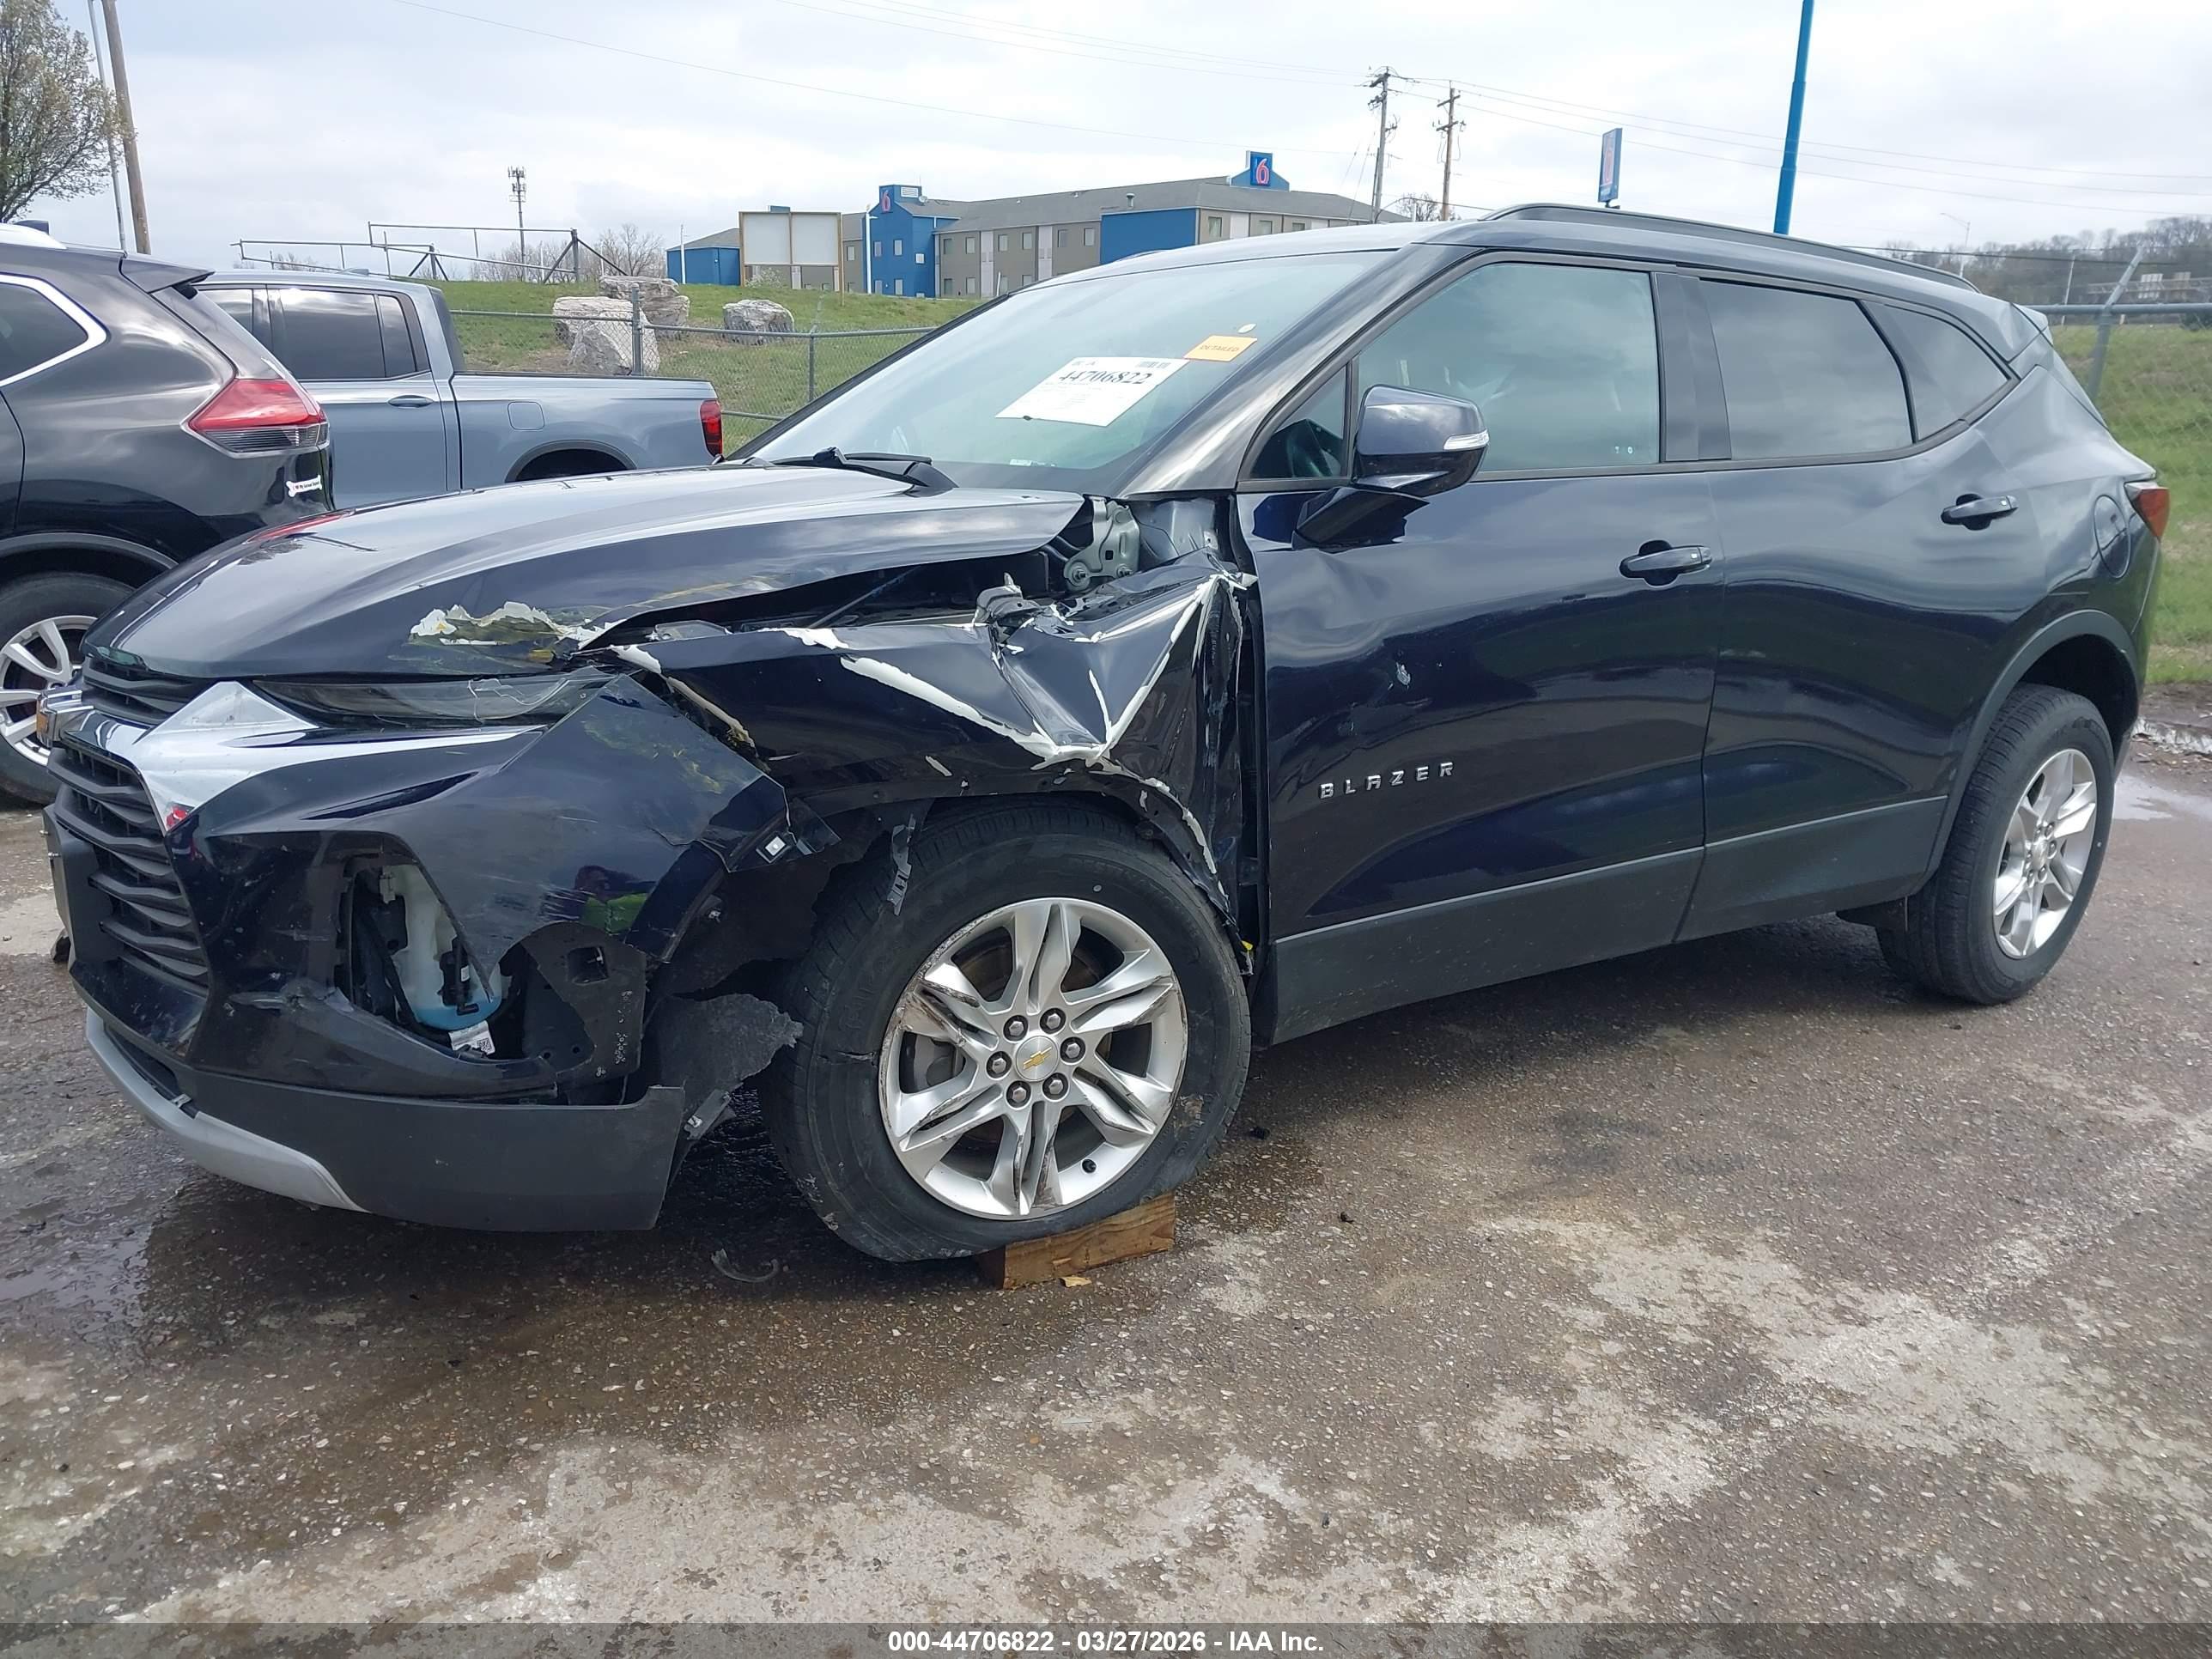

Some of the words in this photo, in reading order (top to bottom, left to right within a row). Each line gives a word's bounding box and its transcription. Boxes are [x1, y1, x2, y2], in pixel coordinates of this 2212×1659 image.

[1255, 158, 1270, 185] 6
[881, 190, 891, 213] 6
[1058, 370, 1152, 385] 44706822
[1319, 762, 1454, 799] BLAZER
